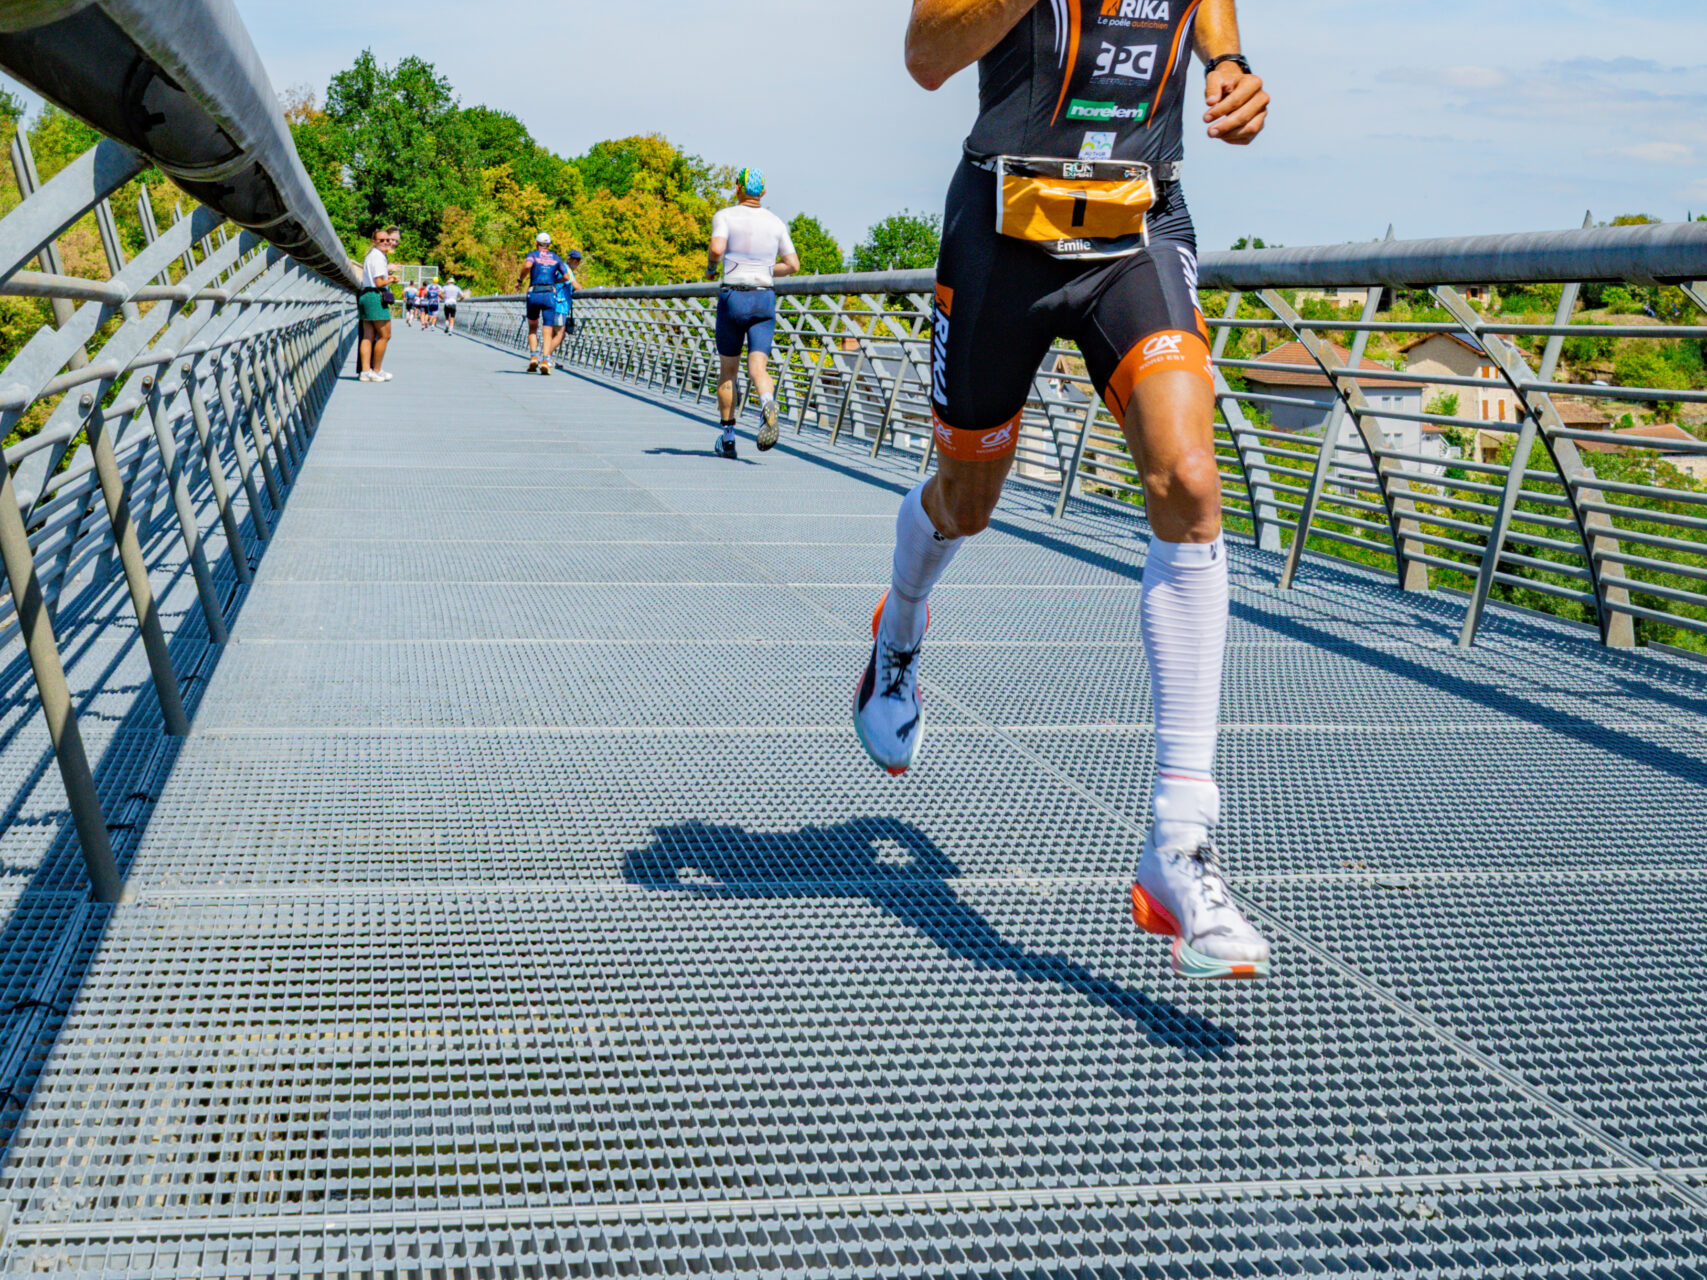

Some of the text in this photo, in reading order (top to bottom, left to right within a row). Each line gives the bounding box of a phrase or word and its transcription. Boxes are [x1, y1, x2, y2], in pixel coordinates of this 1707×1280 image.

[1097, 16, 1109, 25] Le
[1070, 105, 1144, 118] norelem
[1068, 190, 1087, 227] 1
[1057, 237, 1092, 251] Émile
[933, 308, 950, 407] RIKA
